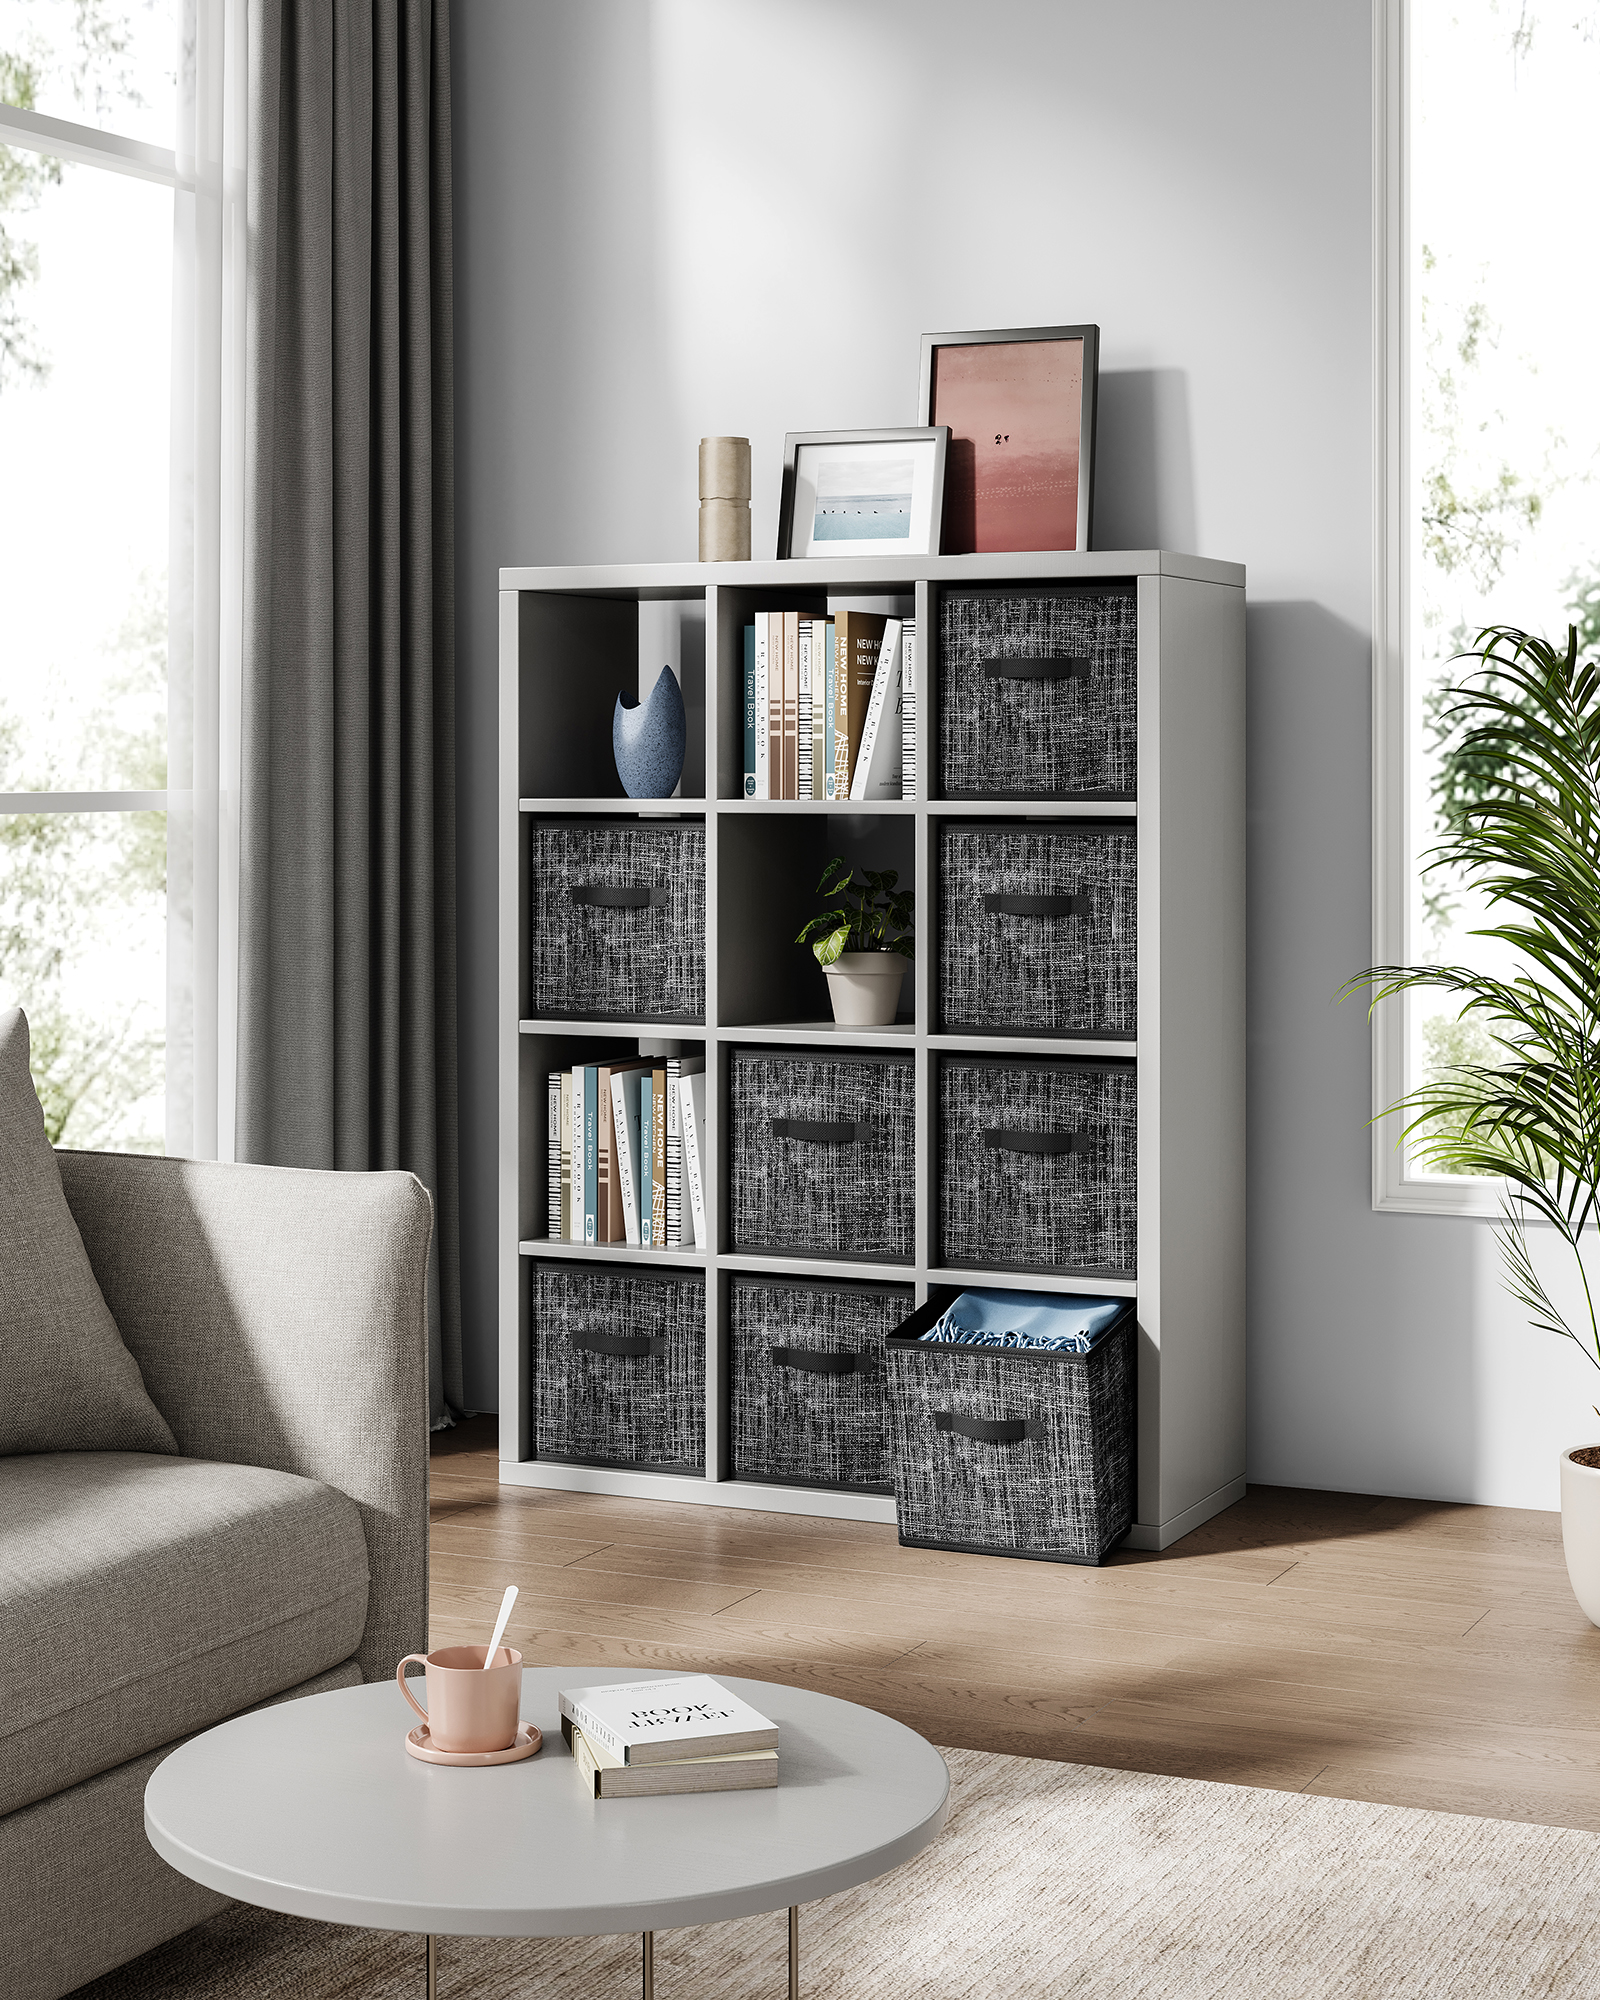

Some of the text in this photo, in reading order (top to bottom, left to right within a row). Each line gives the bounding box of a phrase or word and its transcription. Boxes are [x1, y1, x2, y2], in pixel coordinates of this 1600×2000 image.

[857, 639, 873, 649] NEW
[857, 655, 873, 665] NEW
[747, 670, 755, 728] Travel Book
